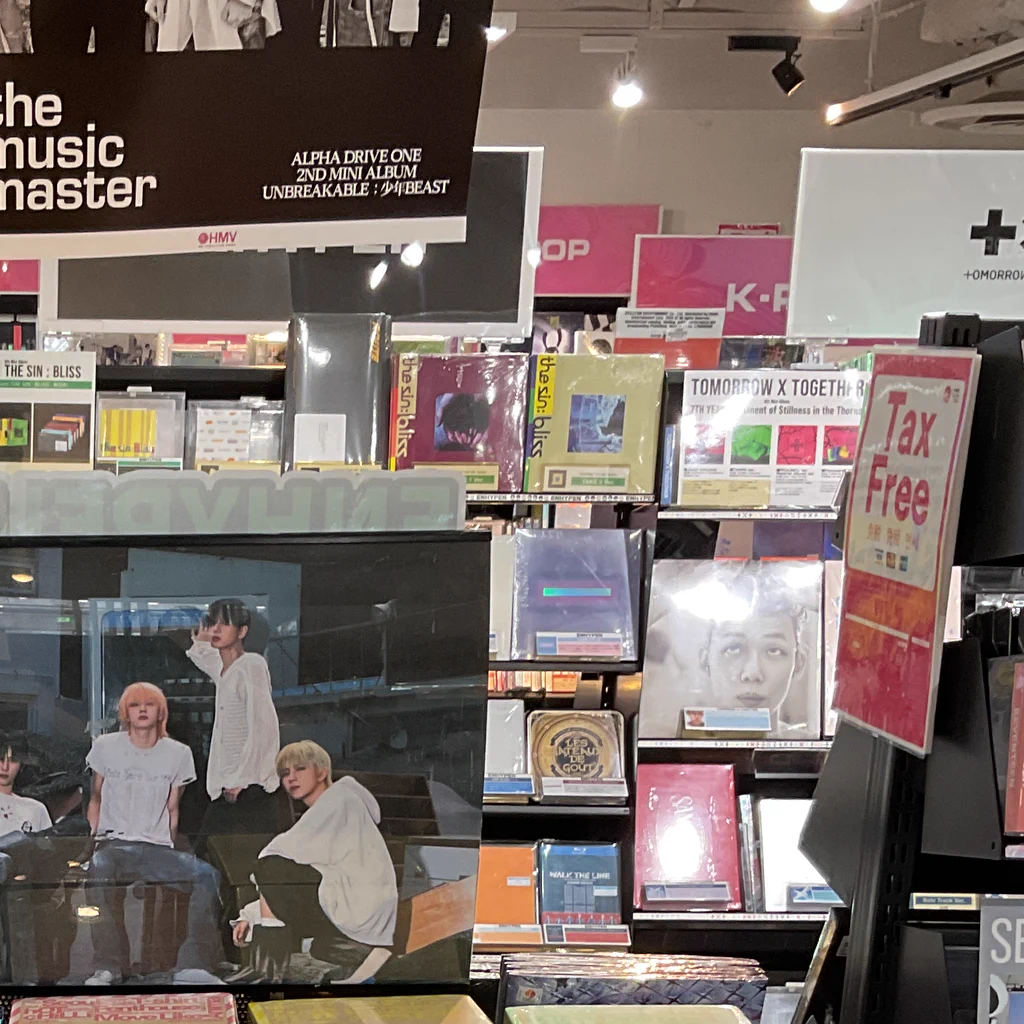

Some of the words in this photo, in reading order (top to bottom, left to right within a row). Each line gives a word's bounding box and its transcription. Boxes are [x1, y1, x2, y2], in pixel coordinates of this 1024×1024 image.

[291, 151, 340, 167] ALPHA
[344, 149, 389, 165] DRIVE
[390, 148, 423, 163] ONE
[296, 167, 327, 182] 2ND
[329, 166, 362, 181] MINI
[366, 165, 417, 180] ALBUM
[262, 183, 369, 200] UNBREAKABLE
[209, 231, 238, 244] HMV
[539, 238, 591, 262] OP
[4, 364, 23, 377] THE
[27, 365, 43, 378] SIN
[53, 366, 81, 378] BLISS
[691, 378, 773, 396] TOMORROW
[777, 379, 787, 396] X
[706, 405, 724, 414] YEA
[779, 406, 811, 415] Stillness
[812, 406, 820, 414] in
[821, 406, 834, 415] the
[884, 391, 938, 459] Tax
[865, 455, 930, 527] Free
